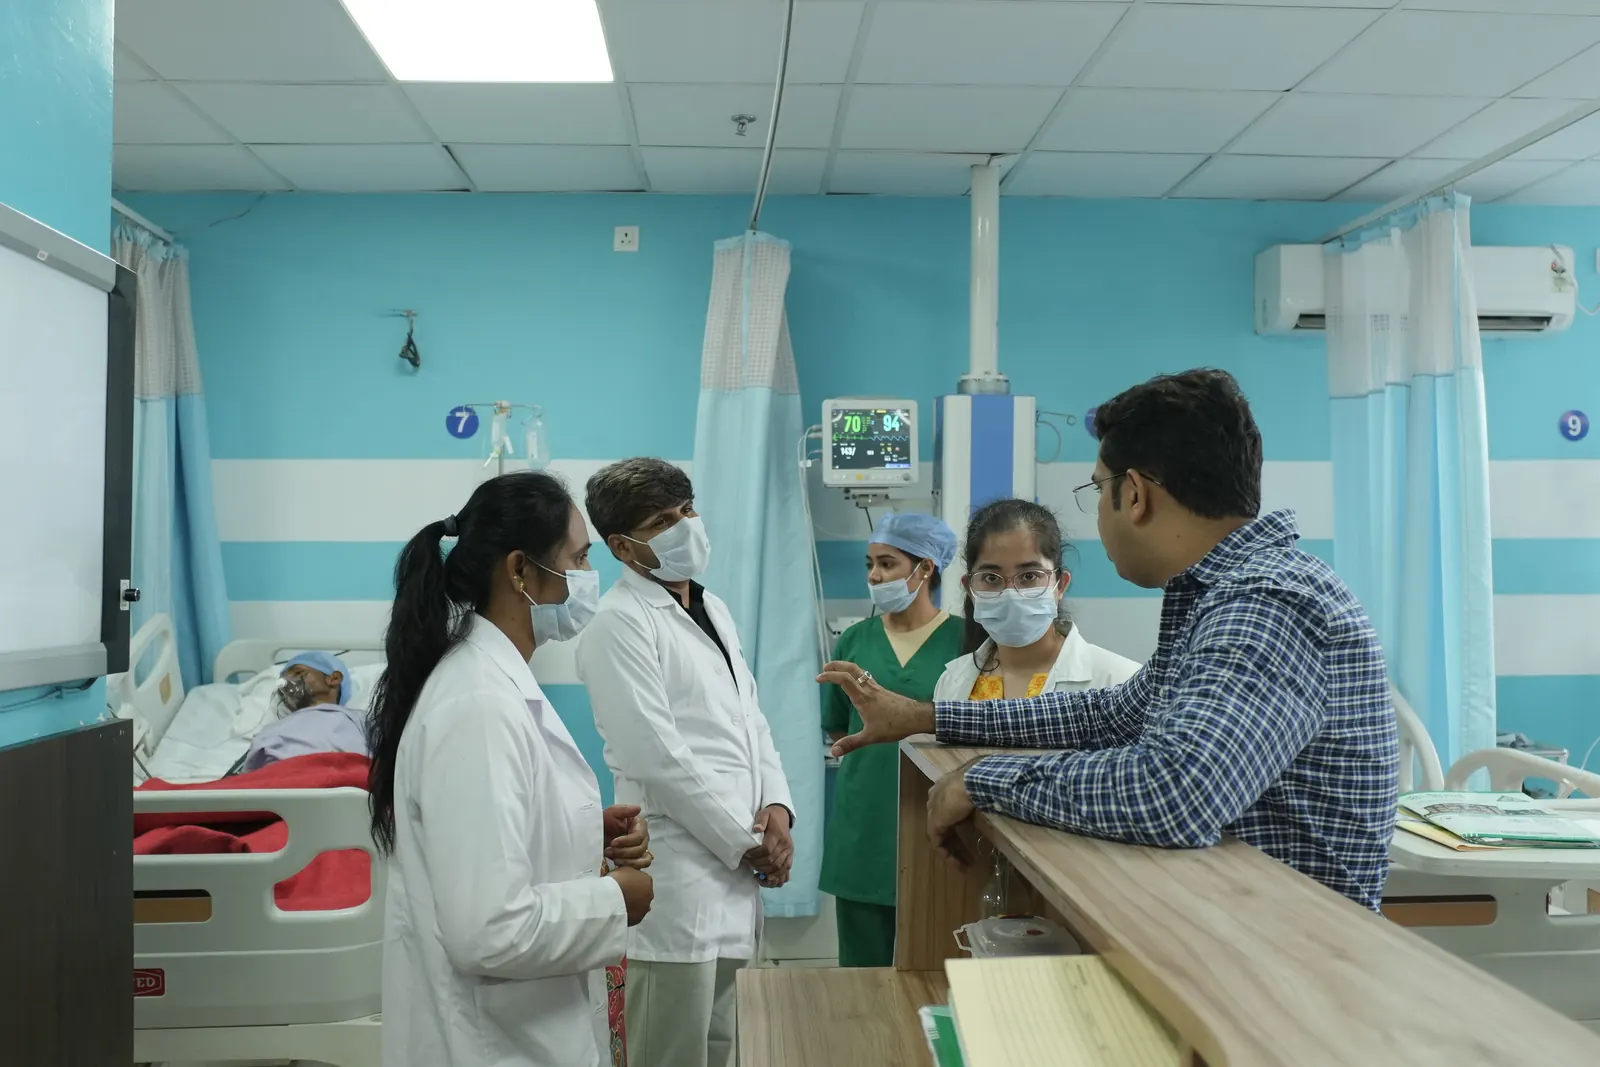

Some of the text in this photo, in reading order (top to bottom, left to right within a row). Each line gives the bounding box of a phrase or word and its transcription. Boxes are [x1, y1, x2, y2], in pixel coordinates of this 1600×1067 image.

[455, 411, 470, 433] 7
[844, 415, 861, 433] 70
[883, 414, 900, 432] 94
[1567, 414, 1582, 437] 9
[132, 976, 156, 988] ED
